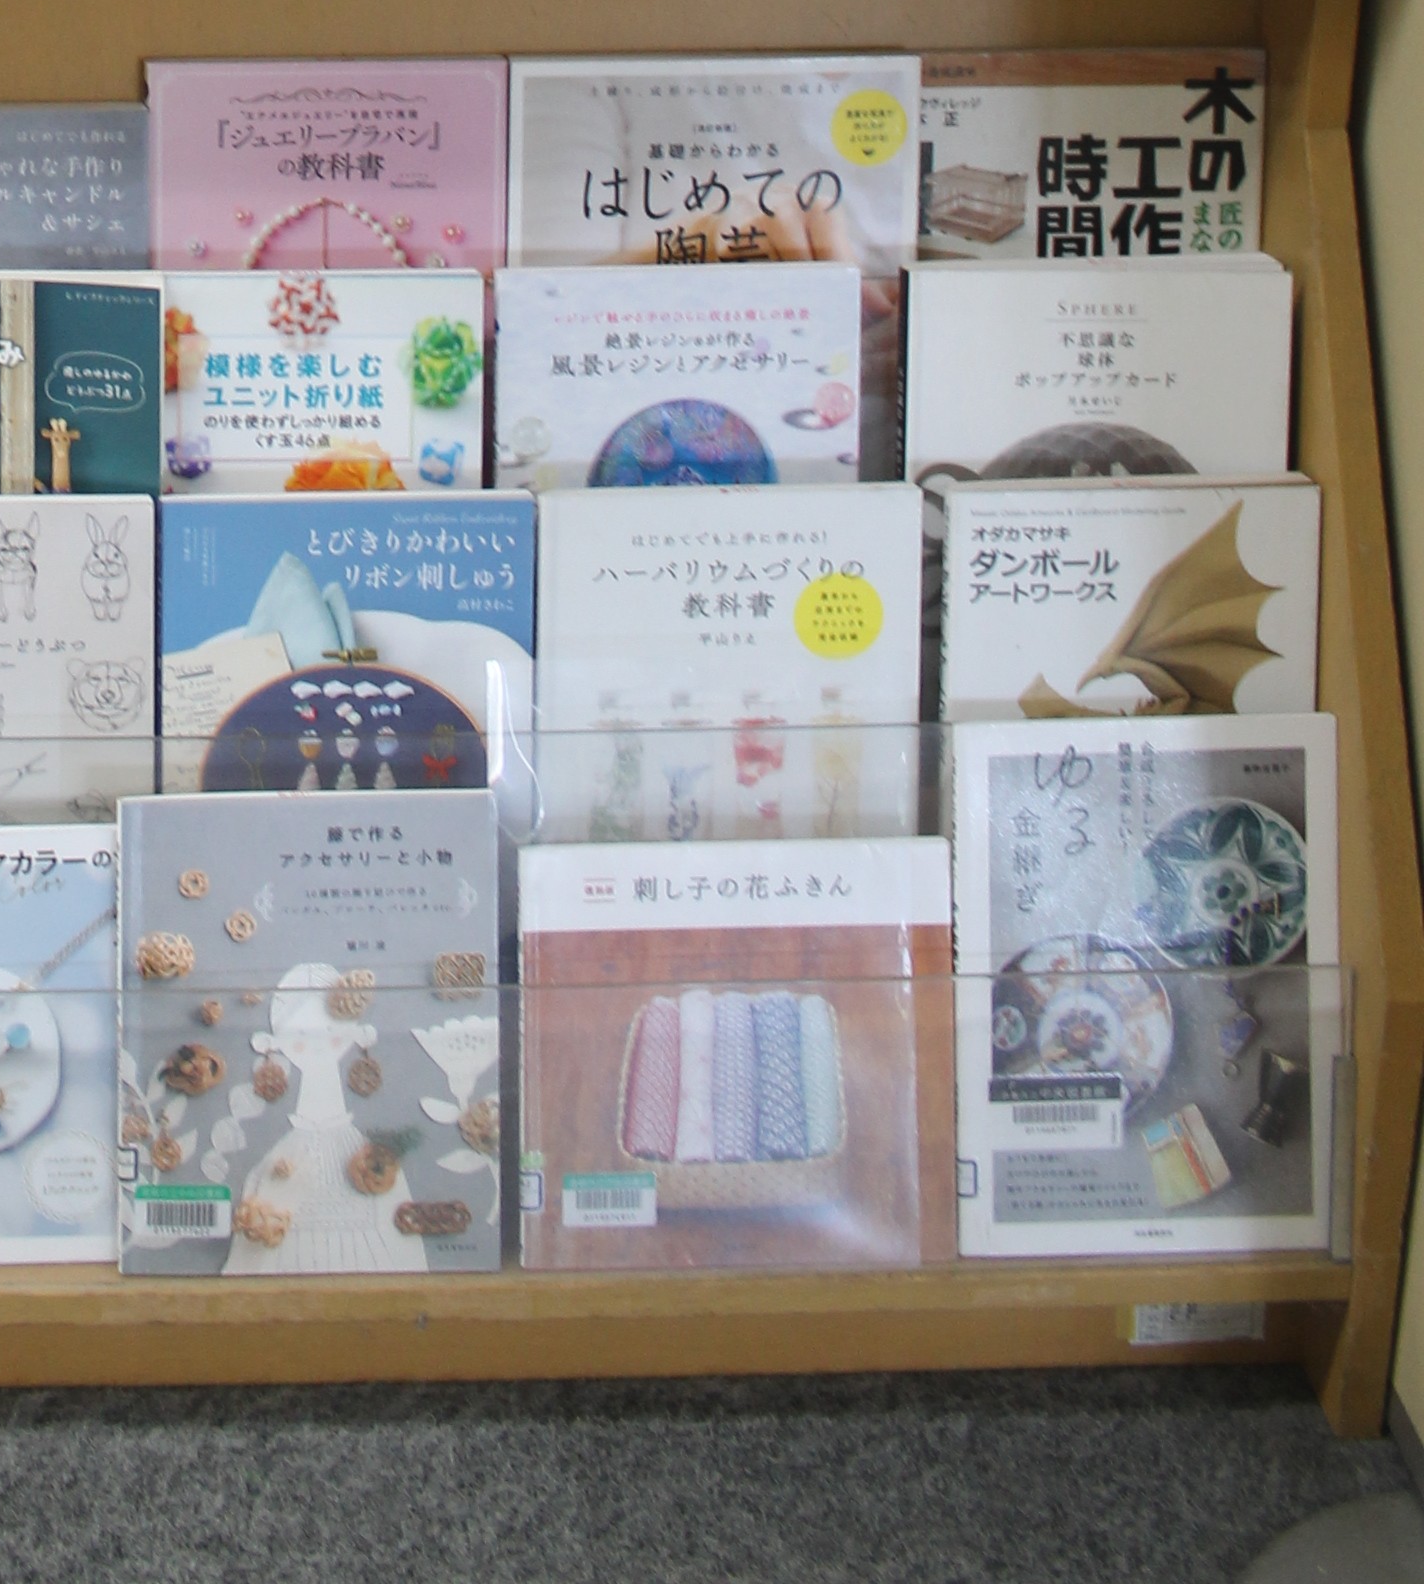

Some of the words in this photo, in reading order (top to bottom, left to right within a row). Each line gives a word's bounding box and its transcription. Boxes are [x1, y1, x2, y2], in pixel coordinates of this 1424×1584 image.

[1182, 65, 1257, 193] 木の
[647, 142, 781, 161] 基礎からわかる
[277, 151, 386, 181] の教科書
[583, 166, 843, 219] はじめての
[1035, 133, 1108, 258] 時間
[1110, 136, 1183, 256] 工作
[654, 224, 772, 265] 陶芸
[1058, 330, 1137, 349] 不思議な
[203, 352, 383, 380] 模様を楽しむ
[550, 350, 812, 377] 風景レジンとアクセサリー
[1077, 351, 1117, 369] 球体
[1013, 371, 1178, 389] ポップアップカード
[202, 384, 385, 410] ユニット折り紙
[203, 414, 382, 430] のりを使わずしっかり組める
[254, 433, 332, 450] くす玉46点
[306, 528, 517, 557] とびきりかわいい
[631, 529, 828, 548] はじめてでも上手に作れる!
[970, 526, 1071, 543] オダカマサキ
[592, 558, 866, 584] ハーバリウムづくりの
[968, 548, 1120, 578] ダンボール
[343, 563, 516, 592] リボン刺しゅう
[681, 591, 777, 619] 教科書
[969, 581, 1118, 604] アートワークス
[325, 825, 405, 843] 籐で作る
[279, 849, 455, 868] アクセサリーと小物
[1011, 805, 1044, 914] 金継ぎ
[631, 873, 854, 903] 刺し子の花ふきん
